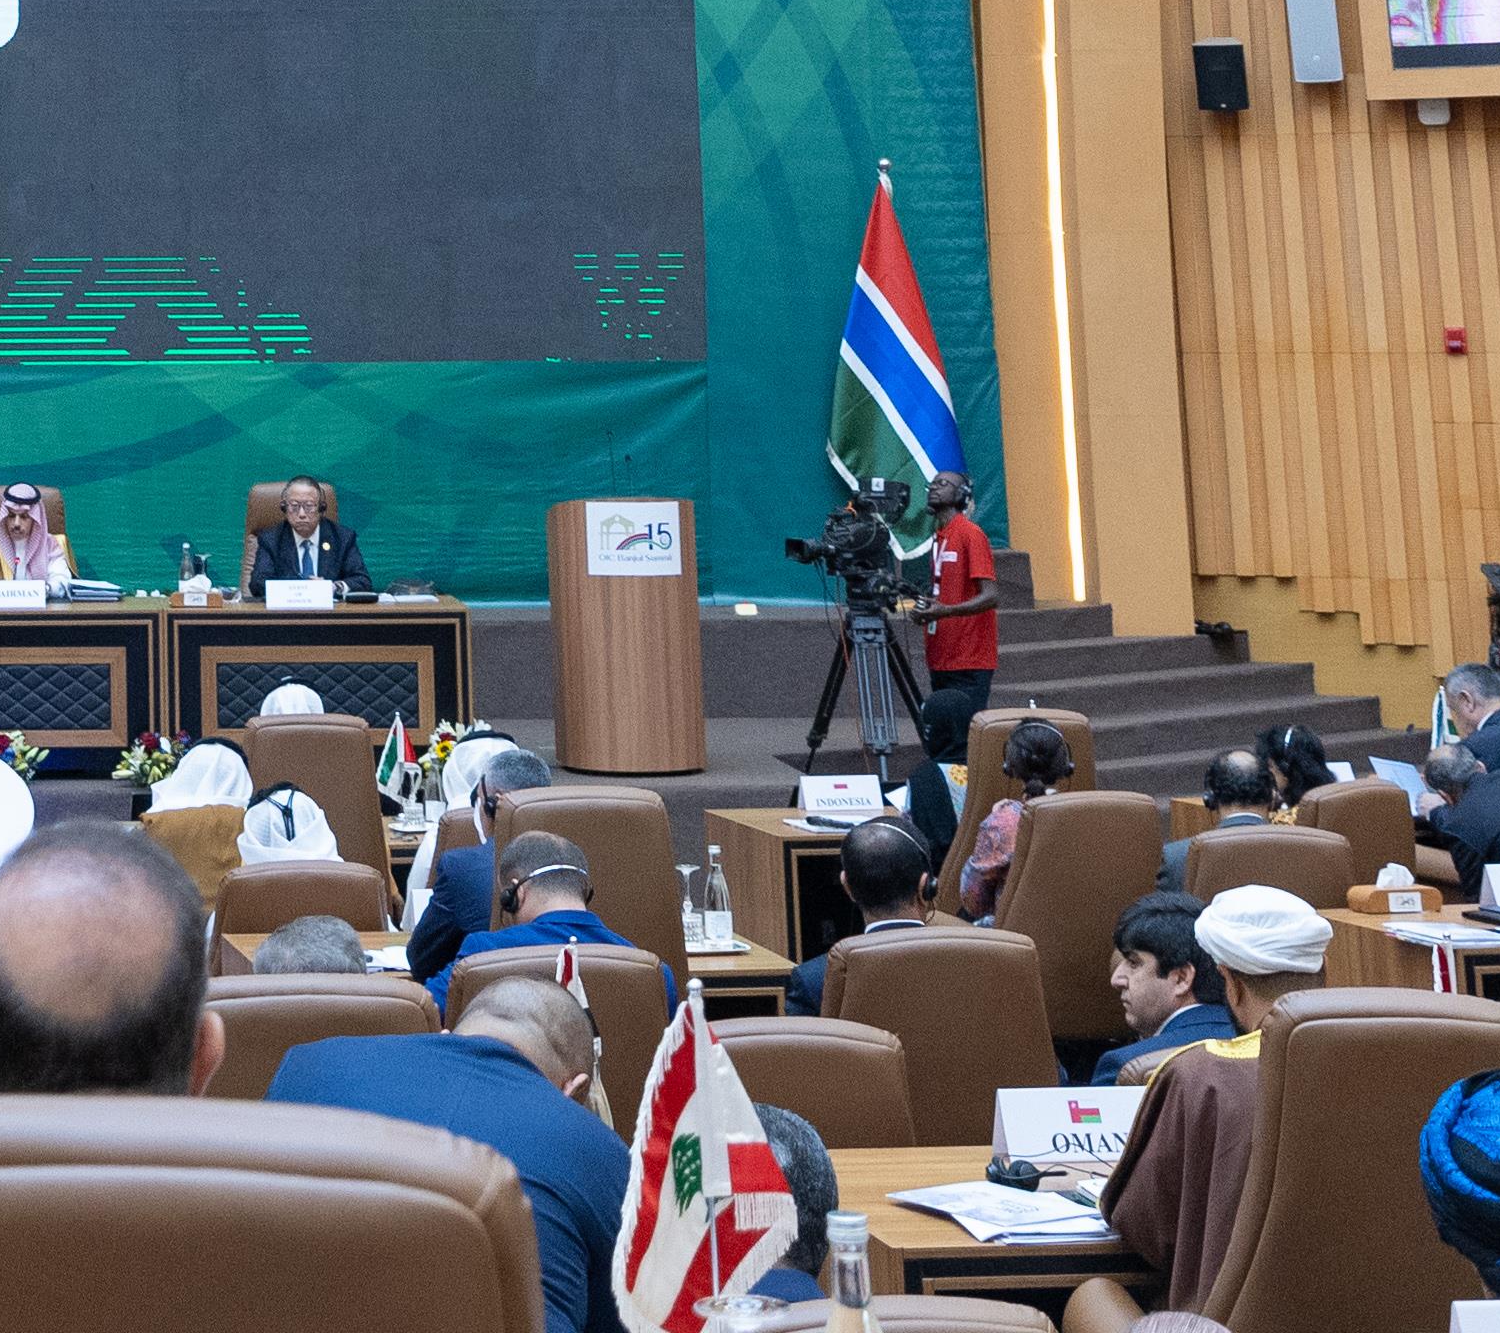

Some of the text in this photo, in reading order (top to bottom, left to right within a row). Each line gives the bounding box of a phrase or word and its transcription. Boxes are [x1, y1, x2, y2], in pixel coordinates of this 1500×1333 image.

[644, 522, 672, 550] 15
[816, 797, 872, 807] INDONESIA
[1052, 1133, 1128, 1154] OMAN
